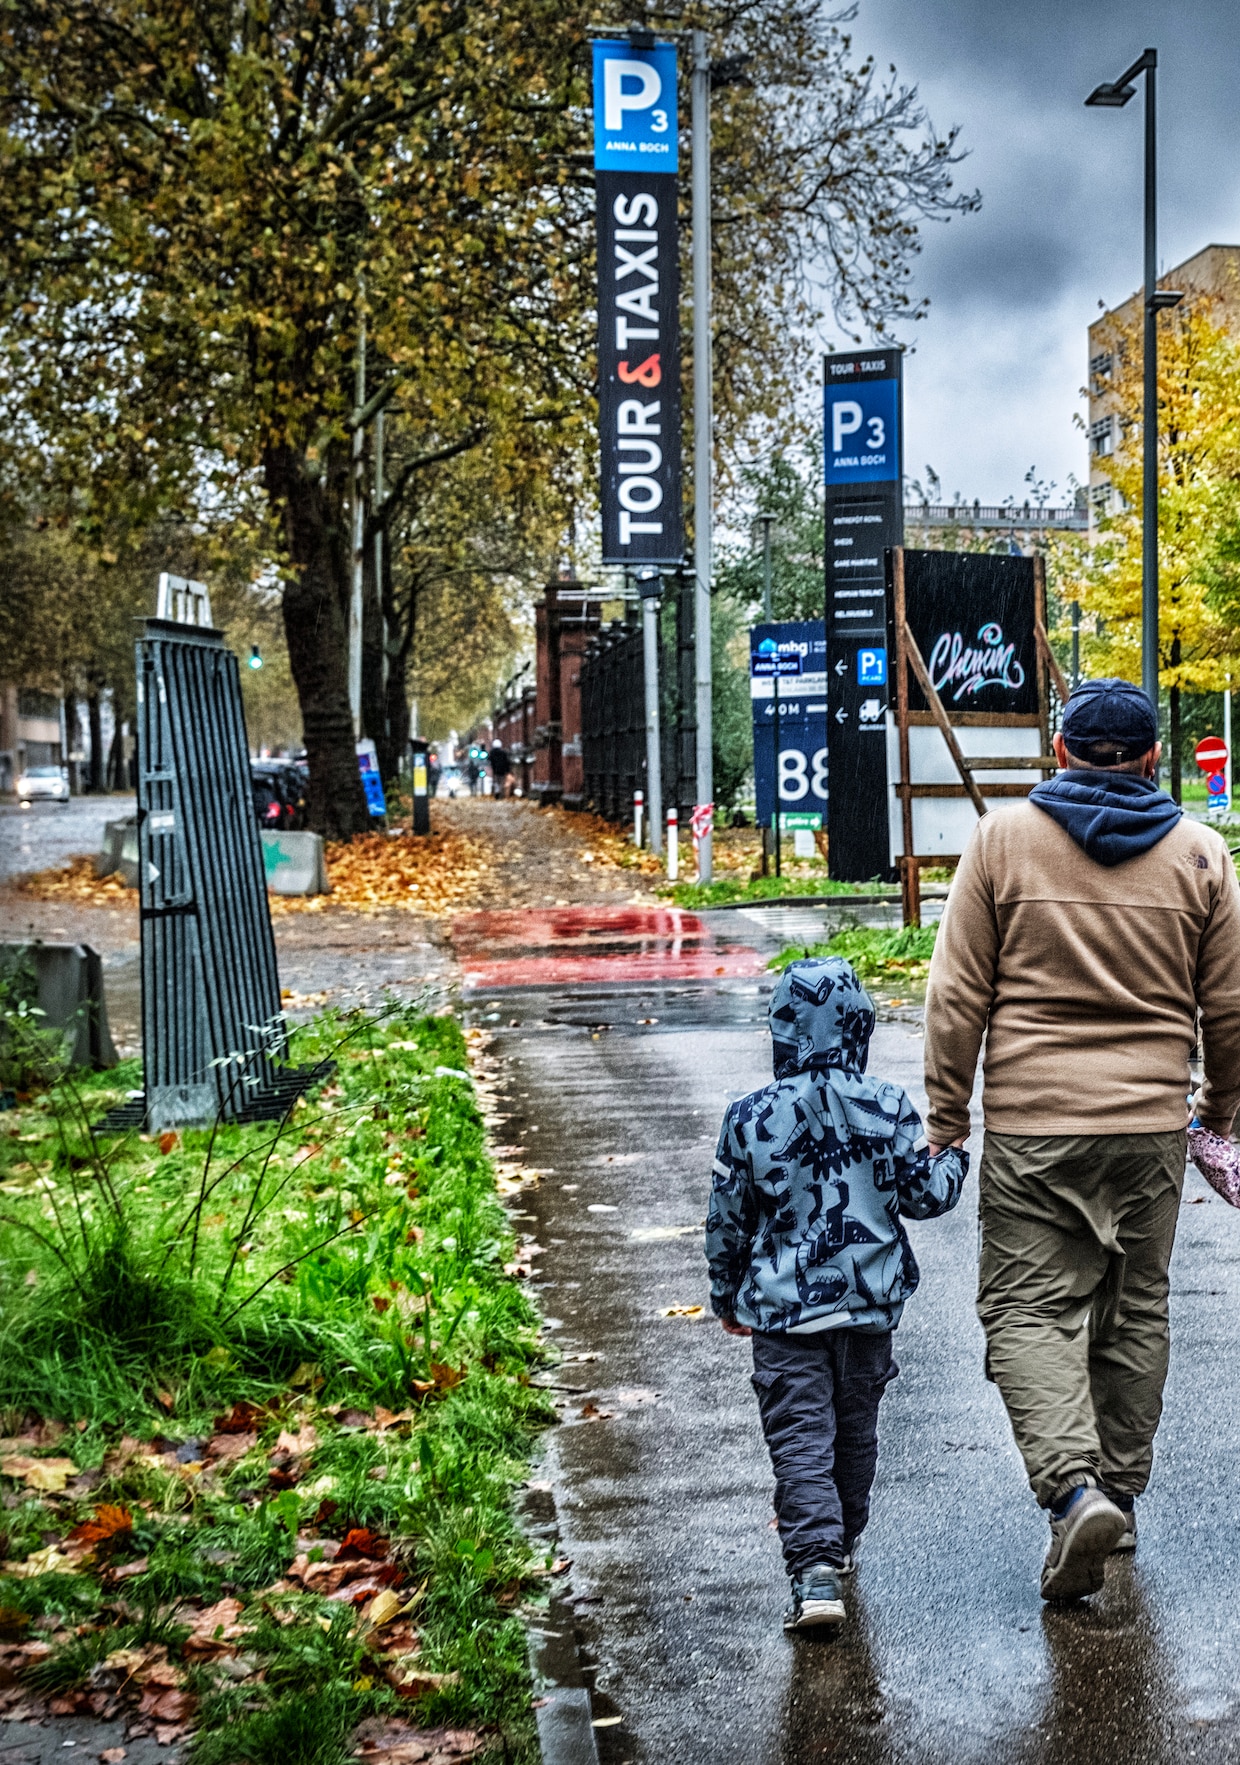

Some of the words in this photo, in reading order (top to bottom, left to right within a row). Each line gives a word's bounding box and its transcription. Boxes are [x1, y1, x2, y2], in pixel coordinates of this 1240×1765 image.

[605, 141, 637, 152] ANNA
[639, 142, 669, 153] BOCH
[613, 192, 660, 351] TAXIS
[617, 353, 662, 388] &
[830, 363, 855, 376] TOUR
[860, 360, 886, 372] TAXIS
[833, 456, 859, 468] ANNA
[860, 454, 886, 466] BOCH
[617, 399, 663, 545] TOUR
[777, 640, 808, 658] mbg
[754, 662, 777, 672] ANNA
